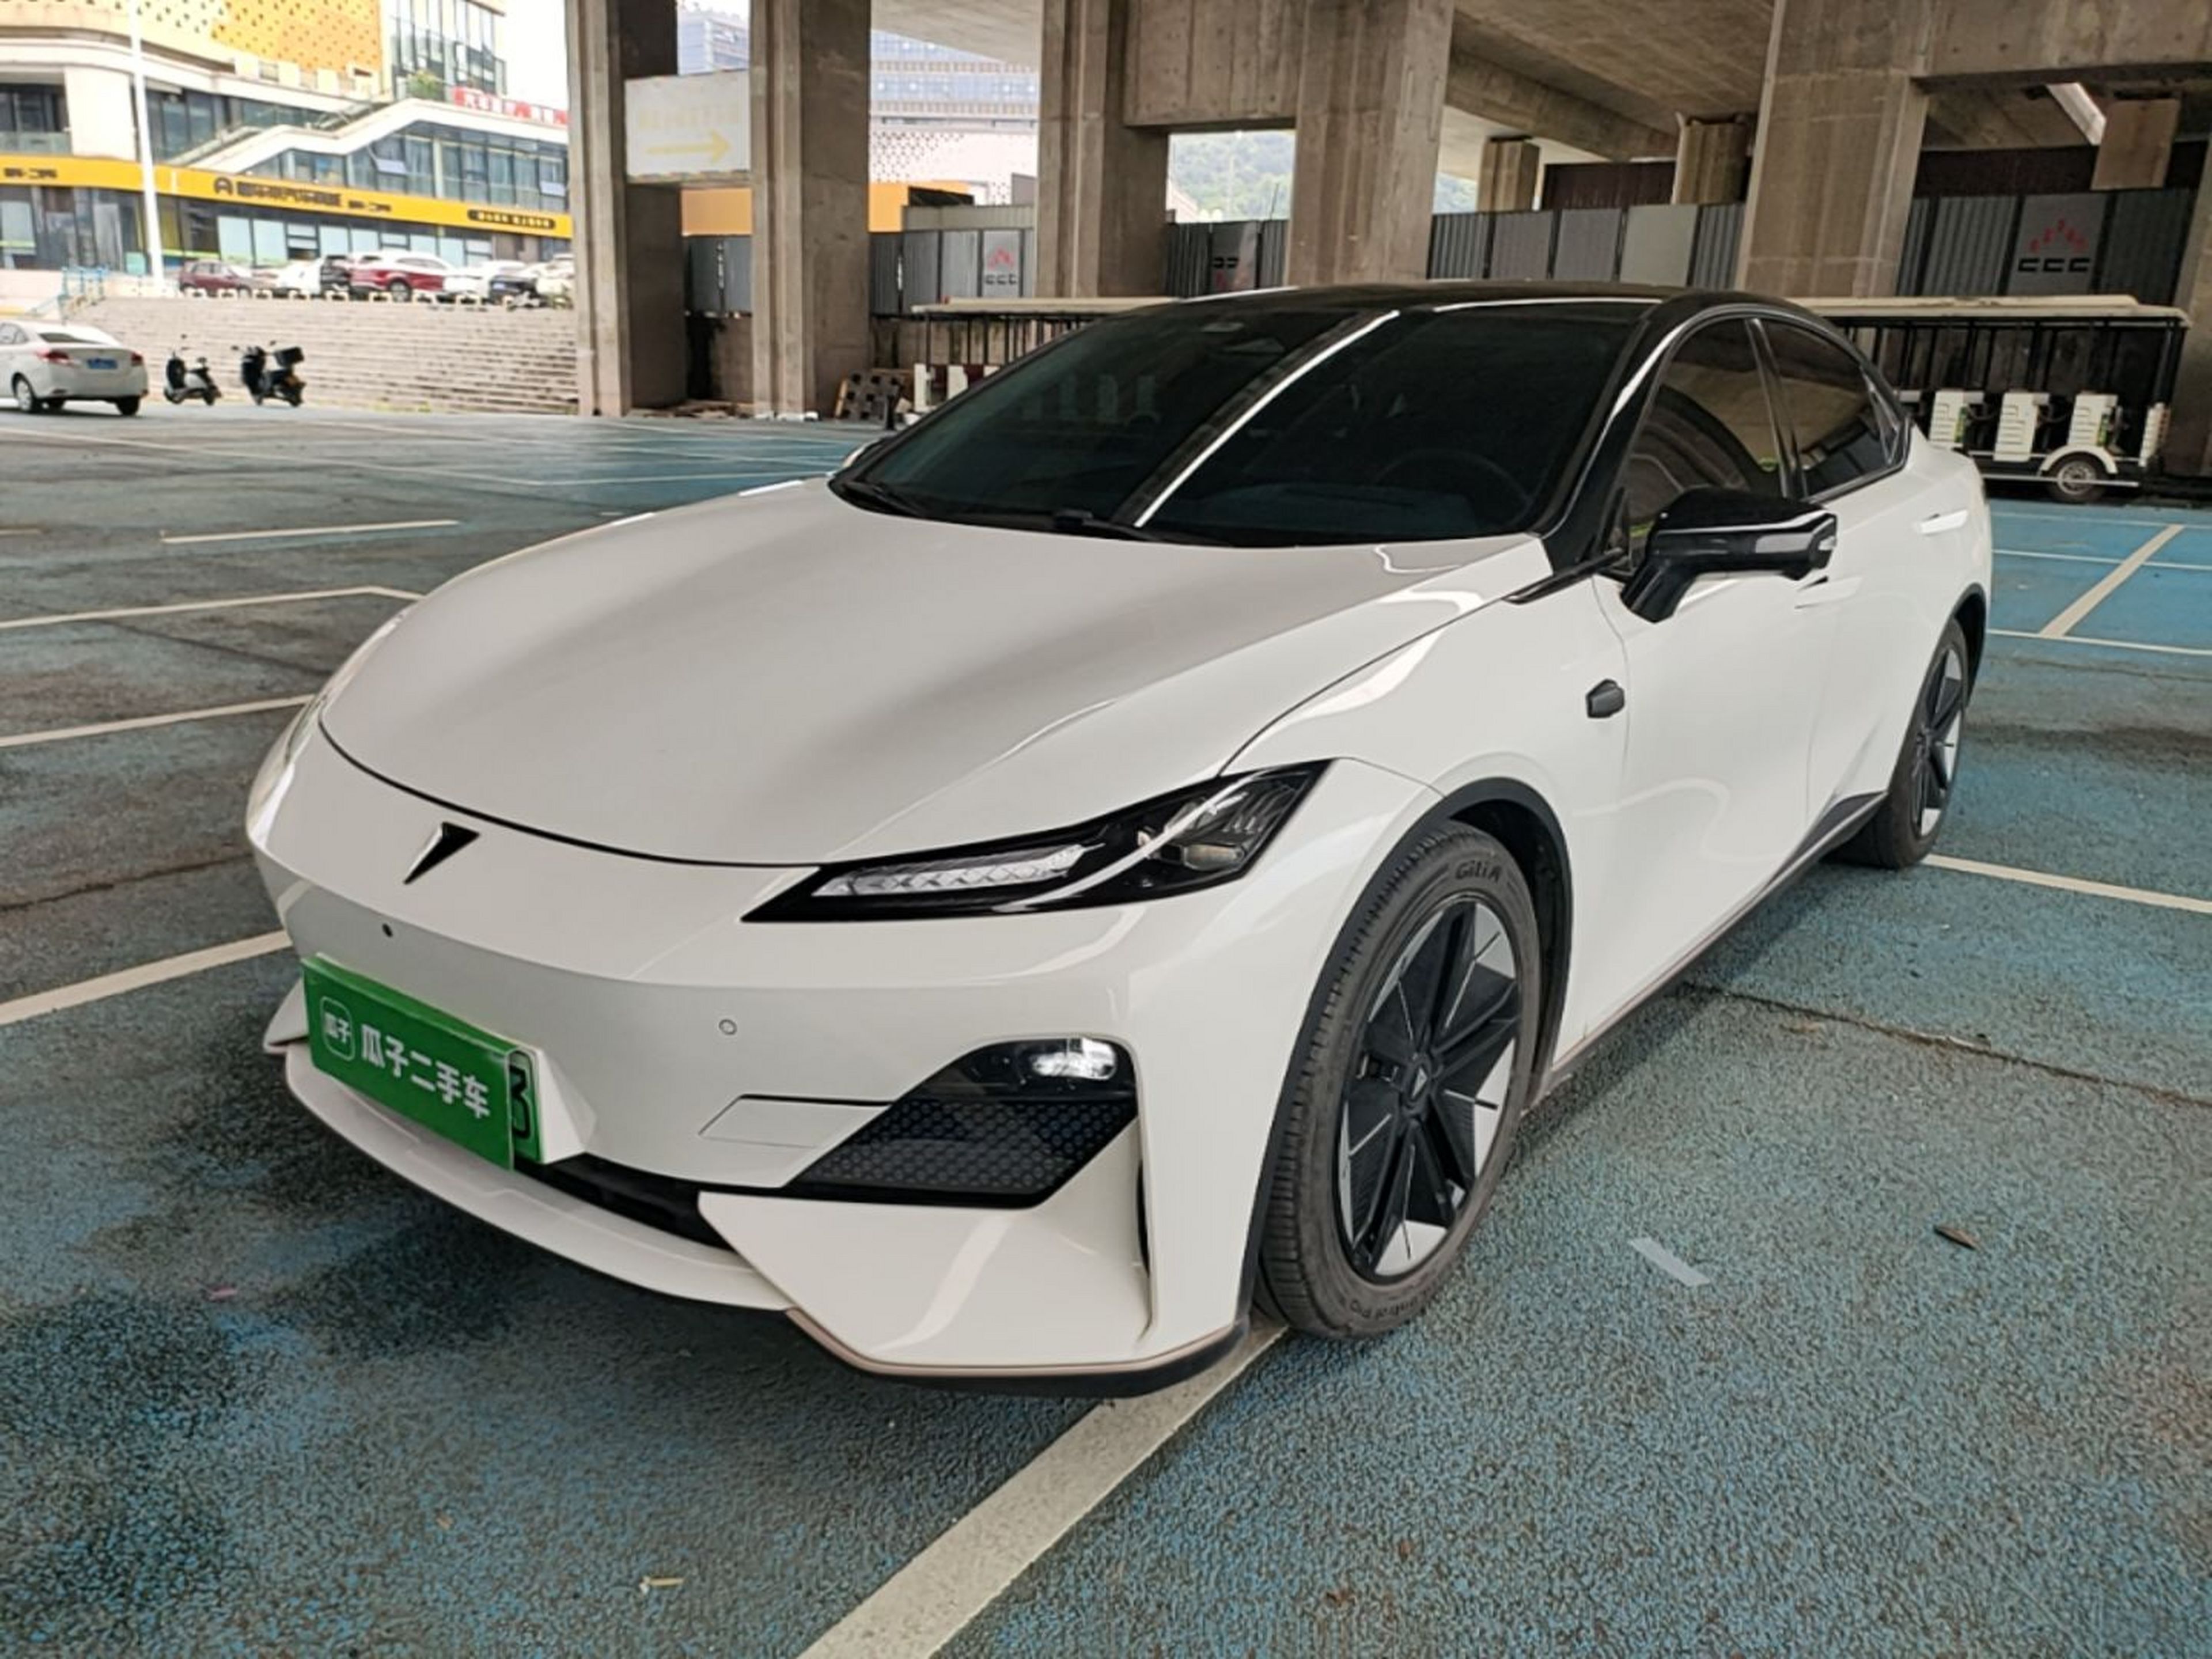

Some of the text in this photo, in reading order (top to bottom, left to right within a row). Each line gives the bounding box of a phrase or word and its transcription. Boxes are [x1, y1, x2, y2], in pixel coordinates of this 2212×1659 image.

[2018, 257, 2090, 273] CCC
[361, 1023, 490, 1119] 瓜子二手车
